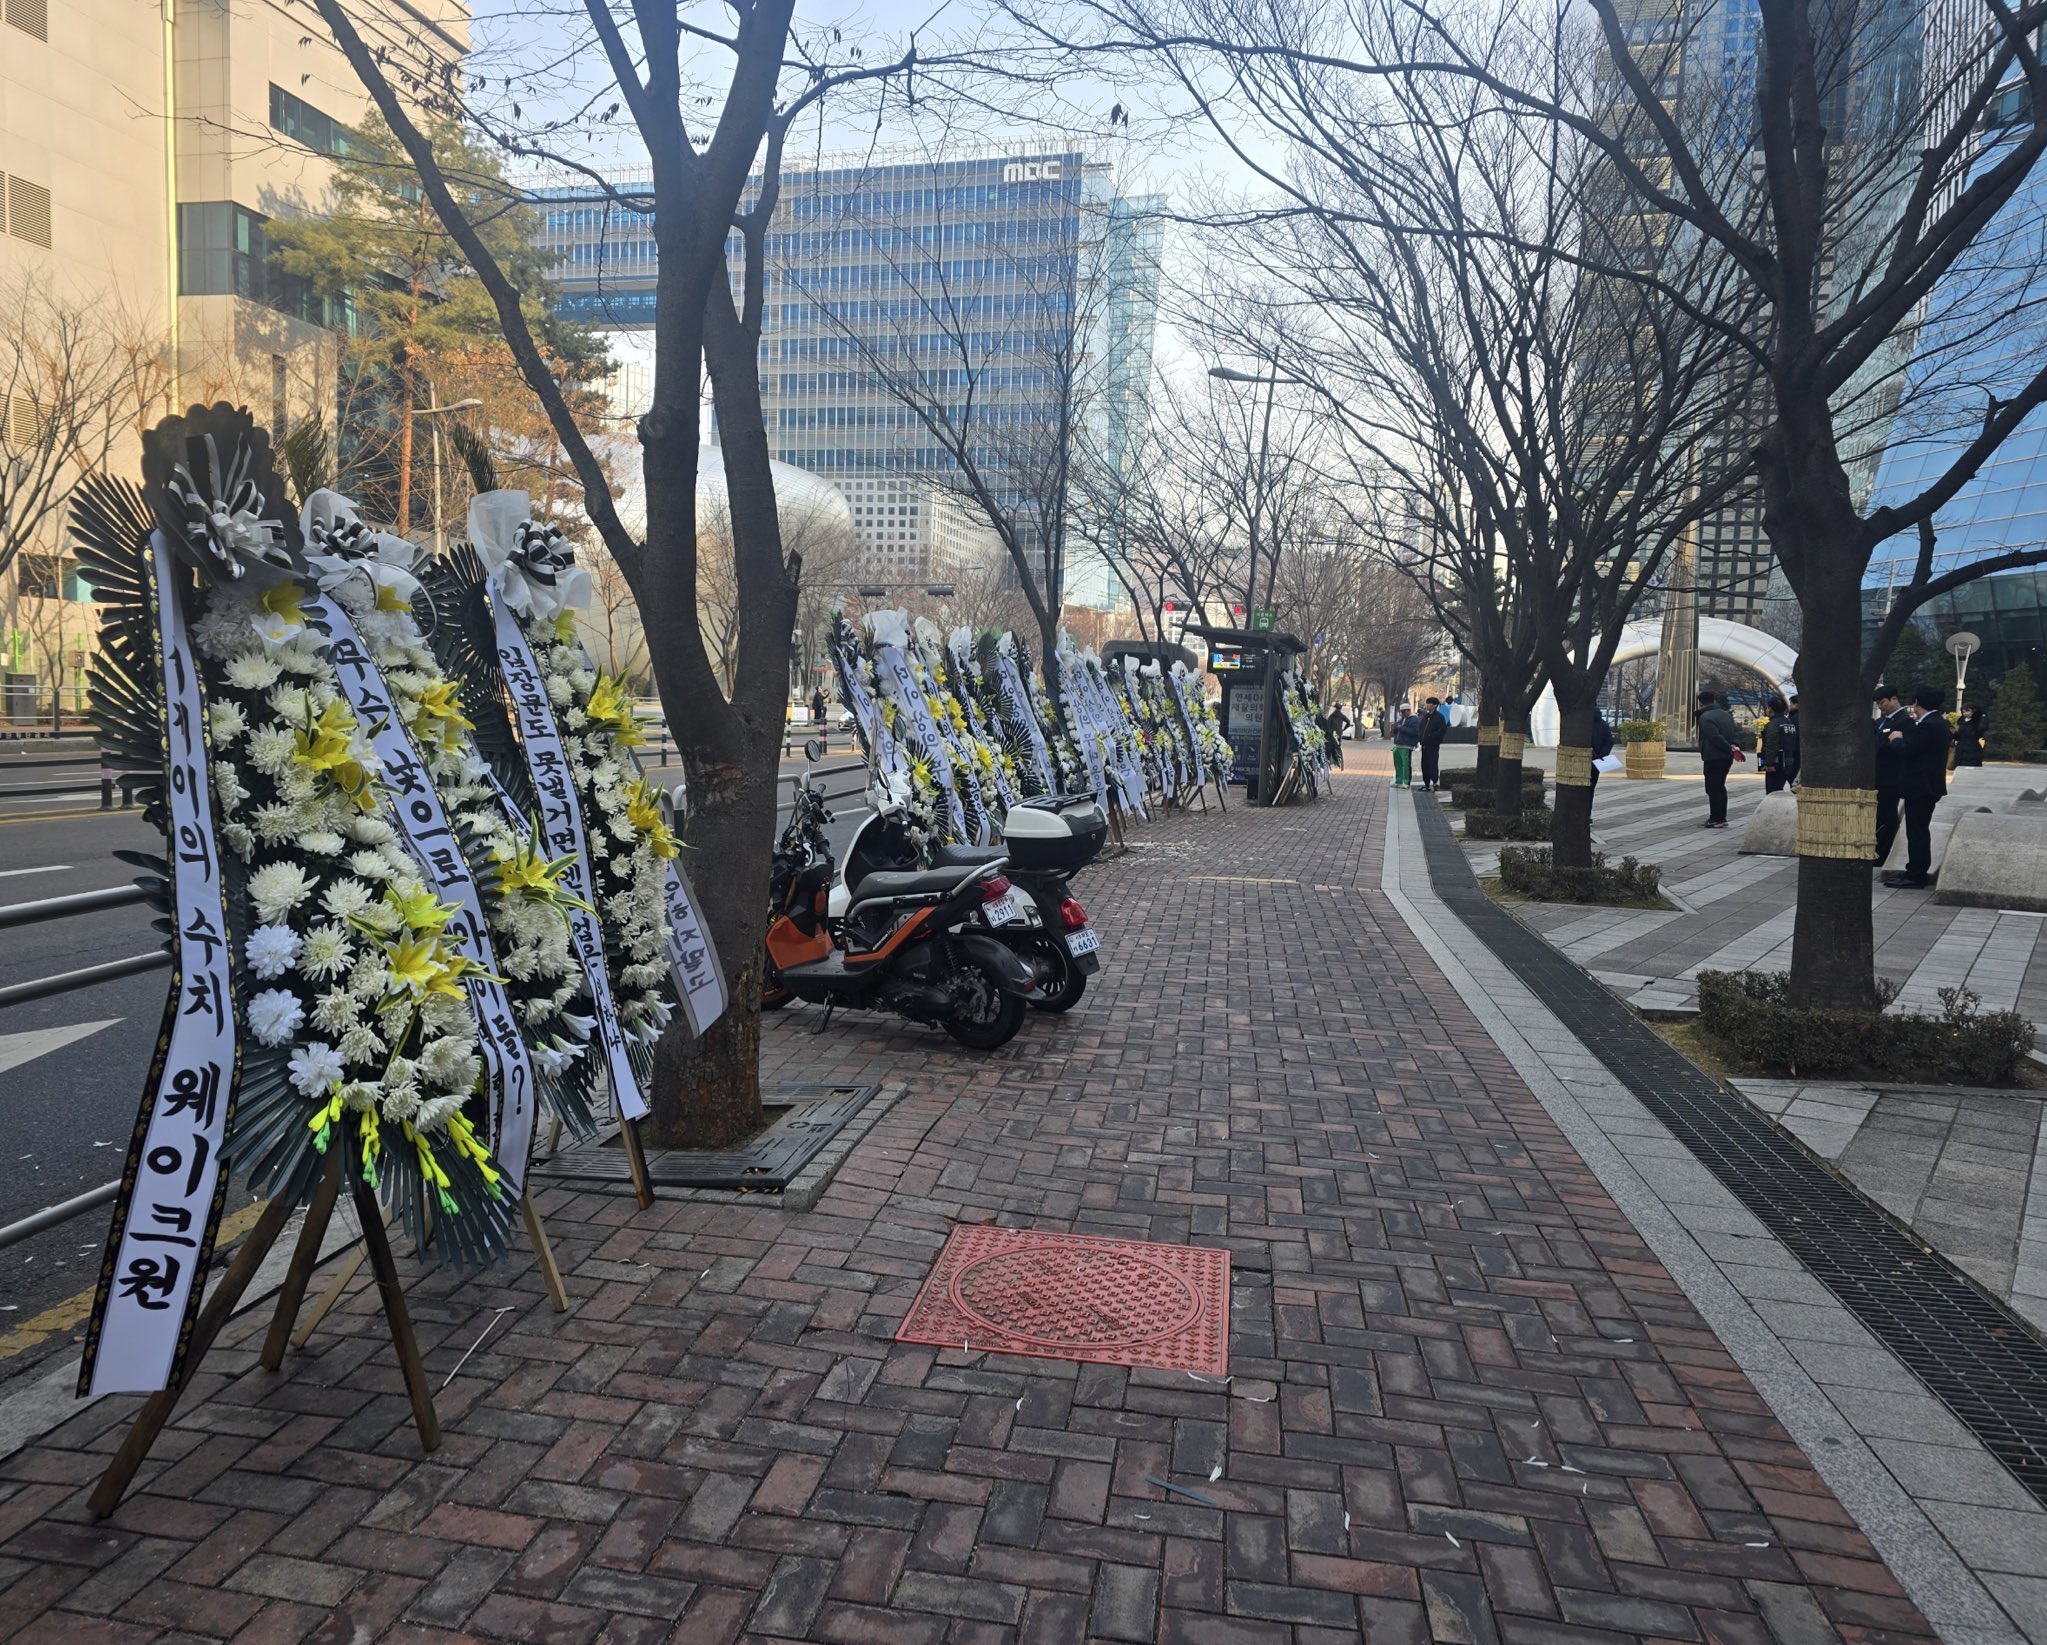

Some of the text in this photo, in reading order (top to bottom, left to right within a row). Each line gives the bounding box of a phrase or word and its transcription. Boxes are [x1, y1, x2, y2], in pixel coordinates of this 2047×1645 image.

[1004, 160, 1060, 183] MBC
[498, 646, 556, 740] 입장문도
[532, 751, 577, 854] 못낼거면
[995, 905, 1014, 921] 2911
[1078, 937, 1098, 951] 6631
[183, 907, 225, 1037] 수치
[118, 1060, 222, 1310] 웨이크원
